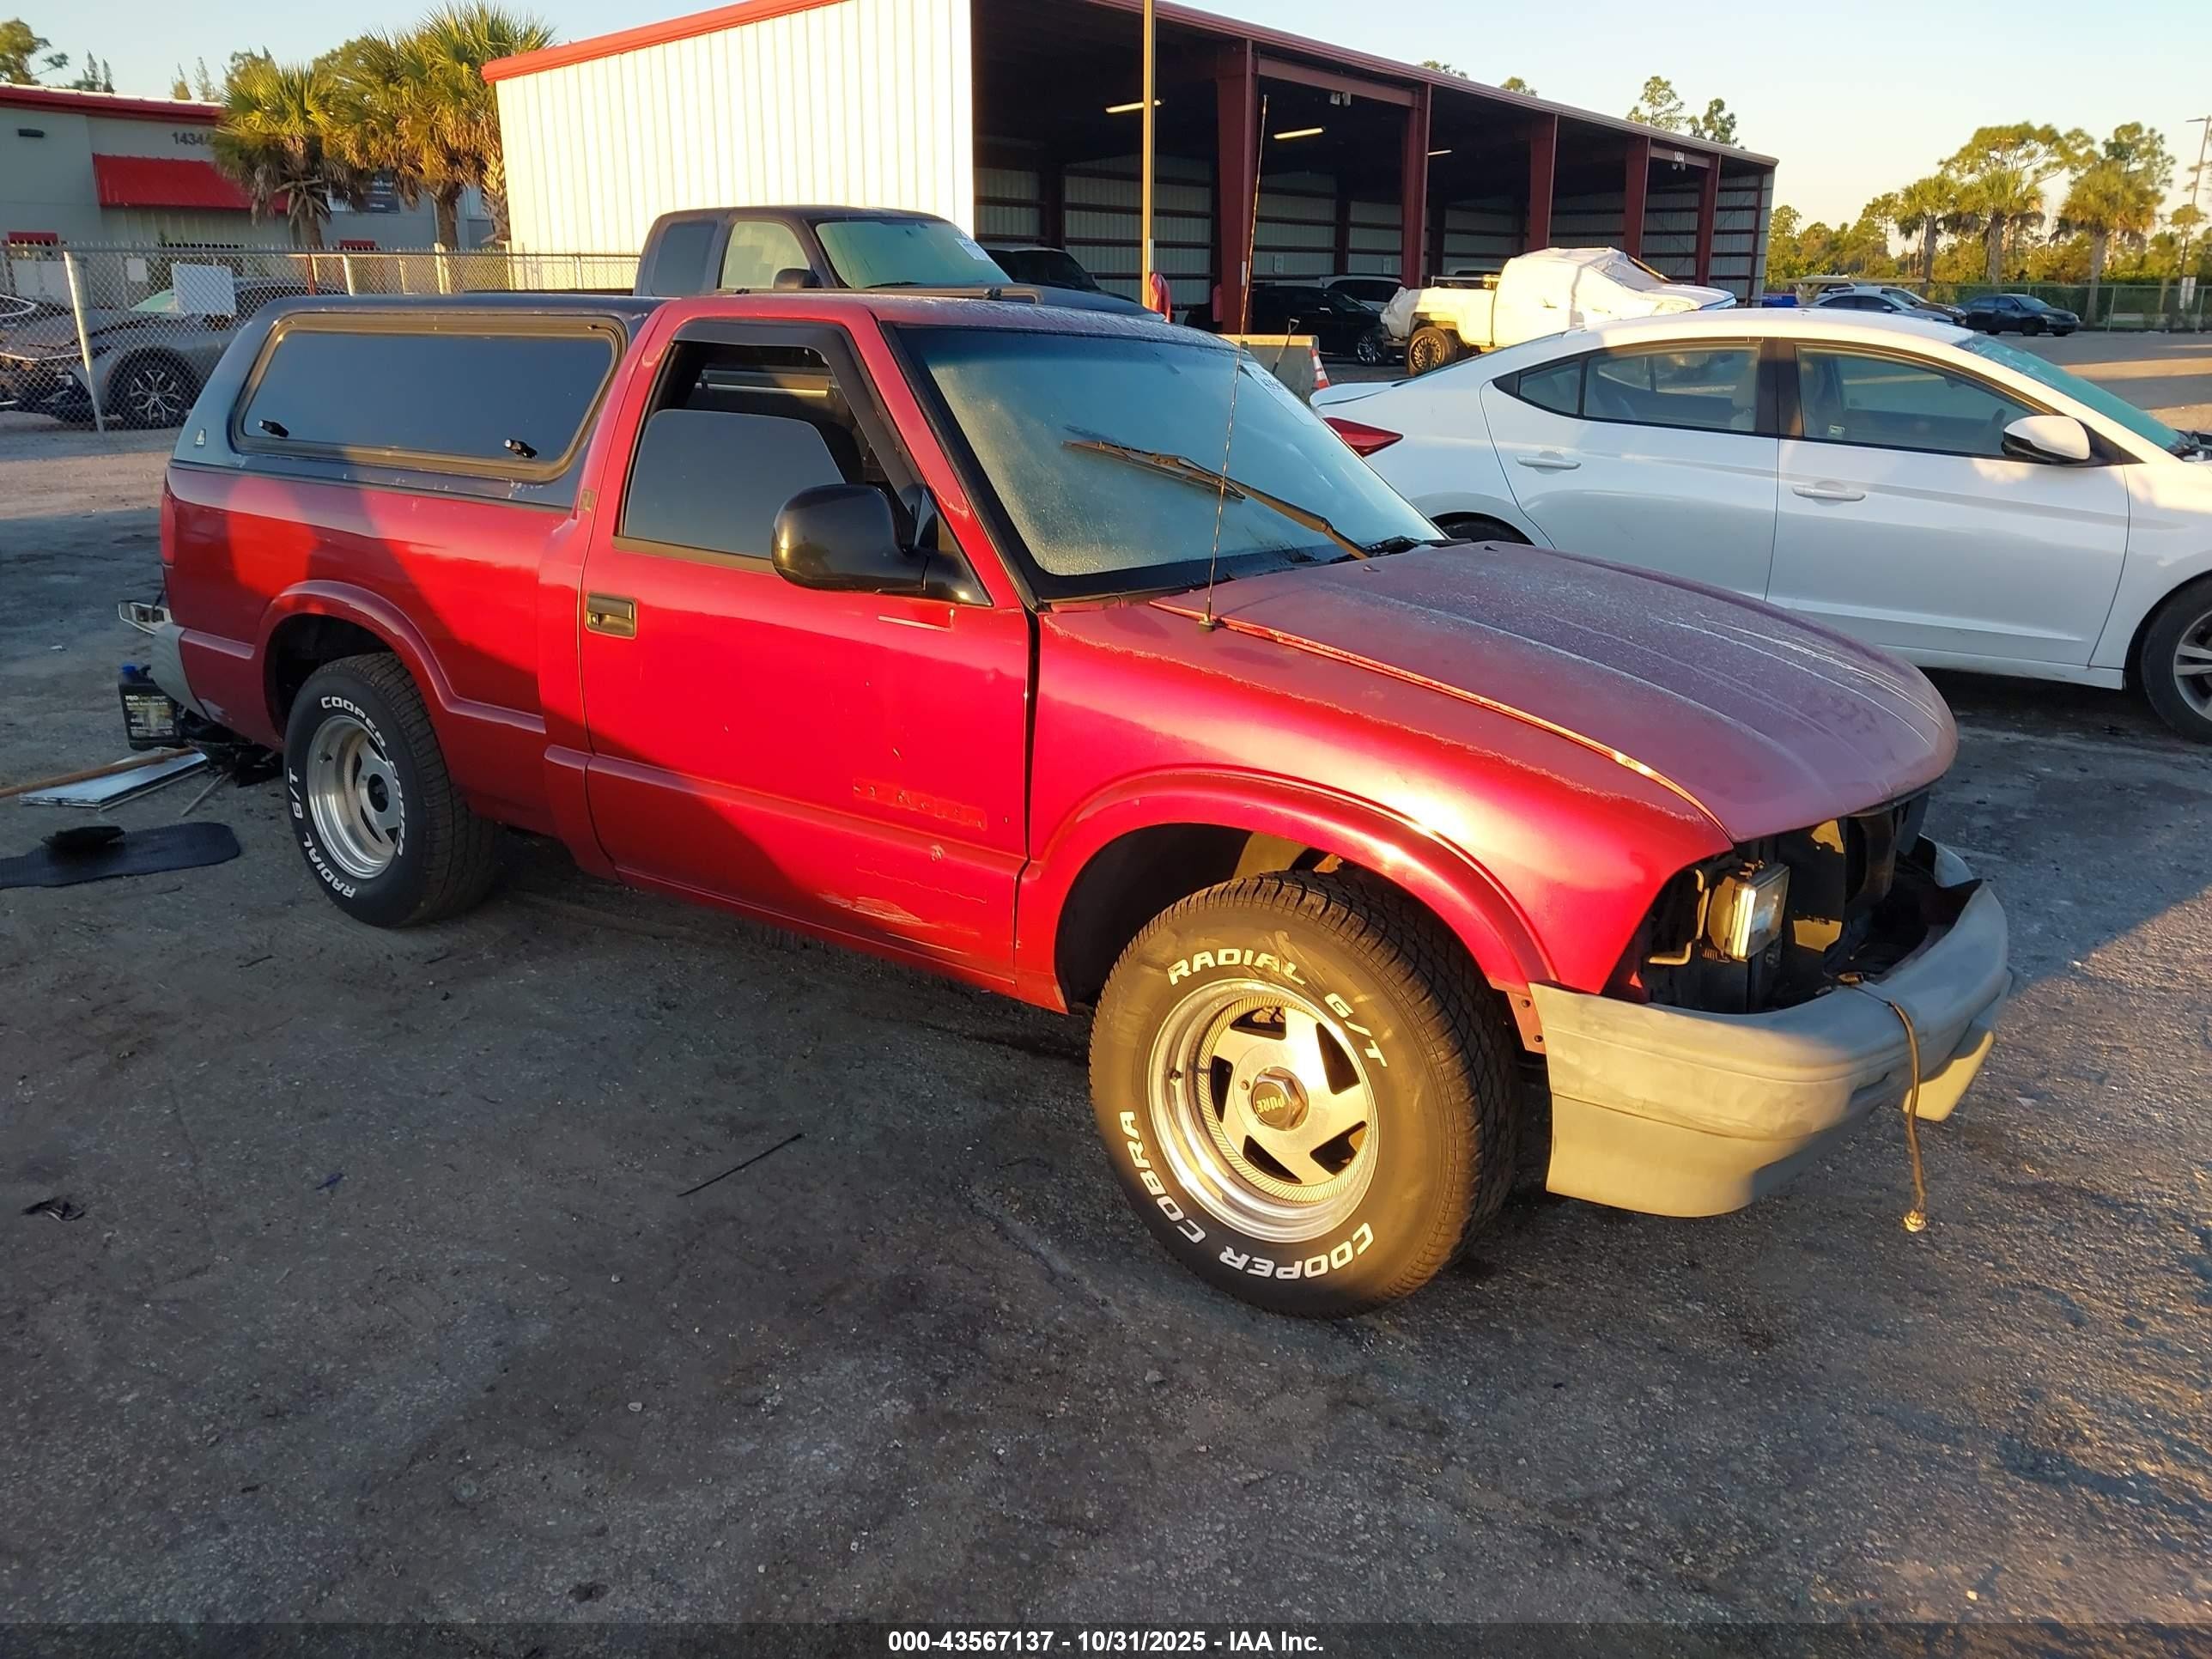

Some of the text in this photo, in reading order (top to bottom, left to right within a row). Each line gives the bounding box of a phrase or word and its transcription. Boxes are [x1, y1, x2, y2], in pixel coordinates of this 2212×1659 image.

[320, 696, 386, 747] COOPER
[288, 767, 356, 899] RADIAL G/T
[1168, 948, 1388, 1067] RADIAL G/T
[1119, 1110, 1374, 1280] COOPER COBRA
